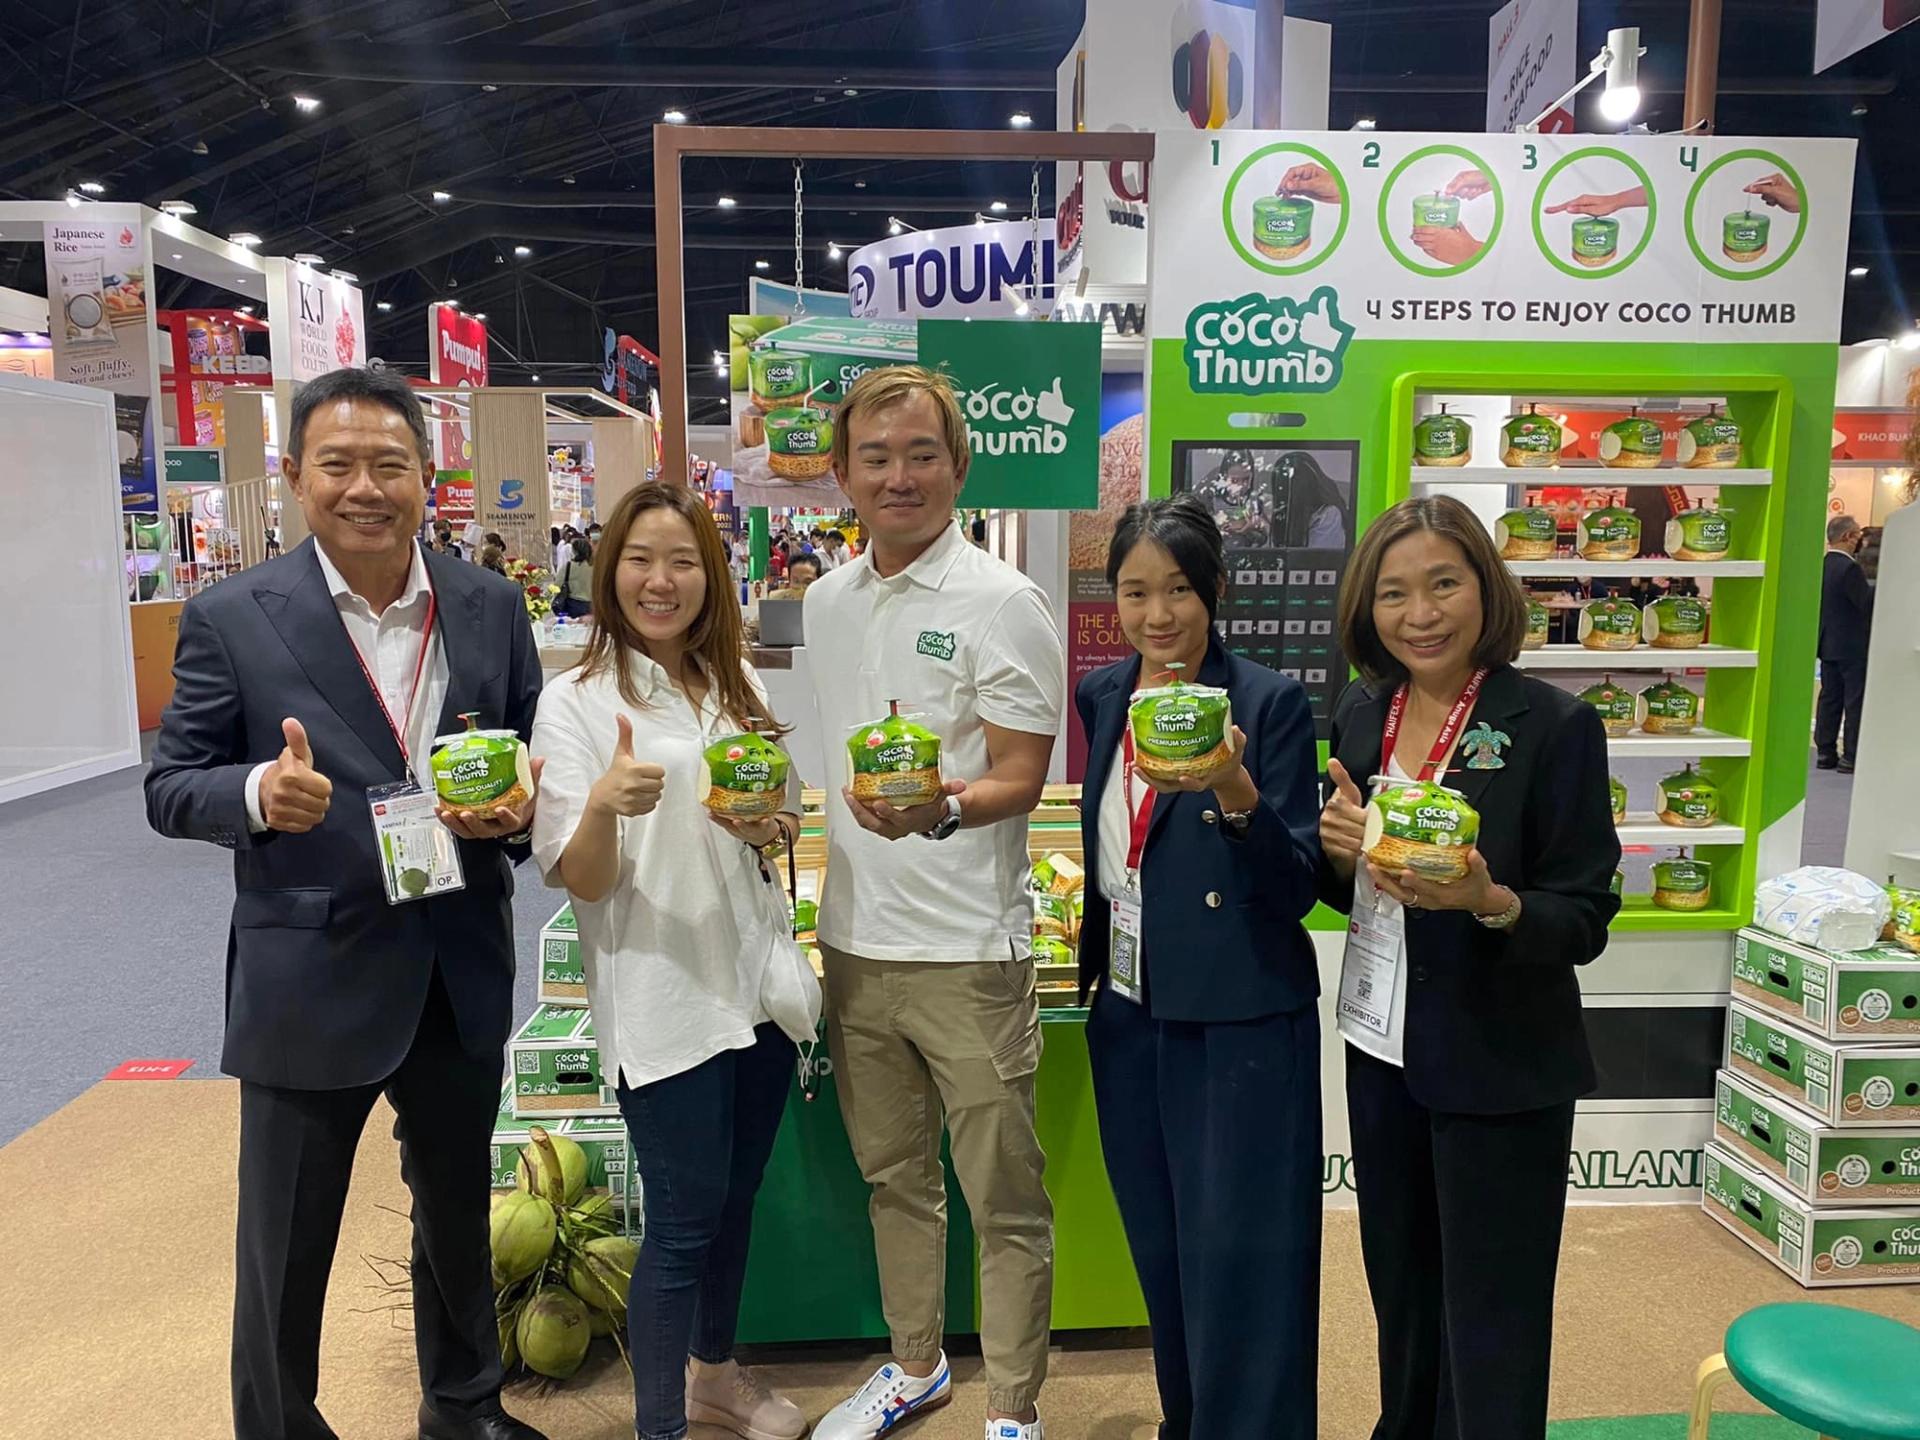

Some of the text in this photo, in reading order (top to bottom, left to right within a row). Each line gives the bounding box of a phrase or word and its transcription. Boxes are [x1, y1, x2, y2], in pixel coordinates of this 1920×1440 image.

[1509, 43, 1531, 97] RICE
[1509, 33, 1553, 130] SEAFOOD
[1210, 140, 1220, 166] 1
[1362, 142, 1381, 168] 2
[1522, 144, 1538, 170] 3
[1679, 146, 1699, 172] 4
[53, 227, 105, 240] Japanese
[54, 241, 78, 252] Rice
[298, 280, 325, 325] KJ
[1366, 300, 1796, 327] 4 STEPS TO ENJOY COCO THUMB
[1193, 349, 1334, 386] Thumb
[966, 424, 1068, 456] humb
[1078, 613, 1106, 629] THE
[1078, 630, 1091, 646] IS
[918, 642, 951, 659] Thumb
[1385, 704, 1400, 738] THAIFEX
[1448, 700, 1466, 727] Anuga
[1154, 720, 1195, 733] Thumb
[1439, 726, 1453, 744] Asia
[1147, 735, 1209, 747] PREMIUM QUALITY
[877, 750, 914, 764] Thumb
[454, 769, 489, 784] Thumb
[735, 771, 769, 781] Thumb
[475, 778, 503, 792] QUALITY
[1416, 817, 1457, 832] Thumb
[1343, 1003, 1382, 1028] EXHIBITOR
[555, 1062, 589, 1071] Thumb
[609, 1162, 621, 1171] 12
[1568, 1149, 1704, 1189] AILAN
[1877, 1266, 1910, 1275] Product
